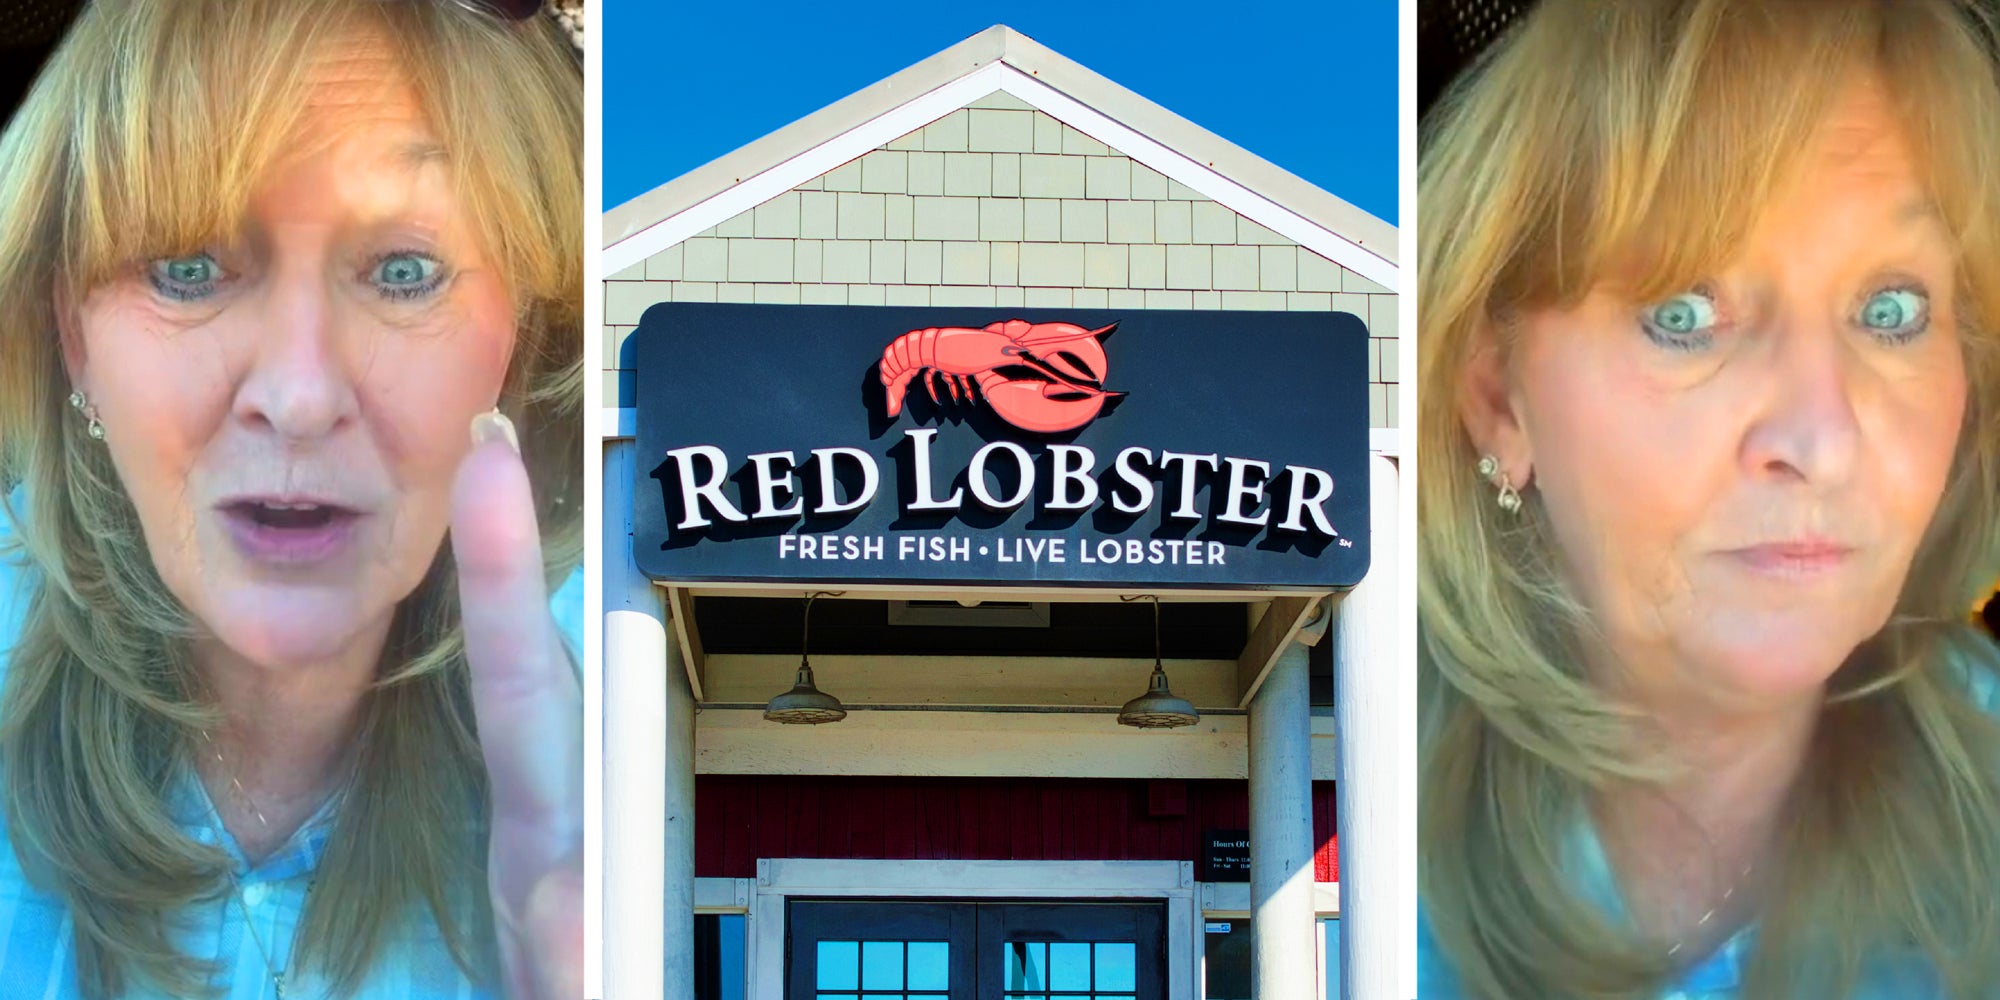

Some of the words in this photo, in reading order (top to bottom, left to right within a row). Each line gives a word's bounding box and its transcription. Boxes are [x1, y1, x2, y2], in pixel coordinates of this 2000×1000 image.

[667, 446, 879, 530] RED
[904, 429, 1338, 537] LOBSTER
[779, 534, 884, 560] FRESH
[898, 536, 970, 562] FISH
[997, 537, 1066, 563] LIVE
[1080, 538, 1226, 565] LOBSTER
[1213, 840, 1234, 848] Hours
[1235, 840, 1245, 848] Of
